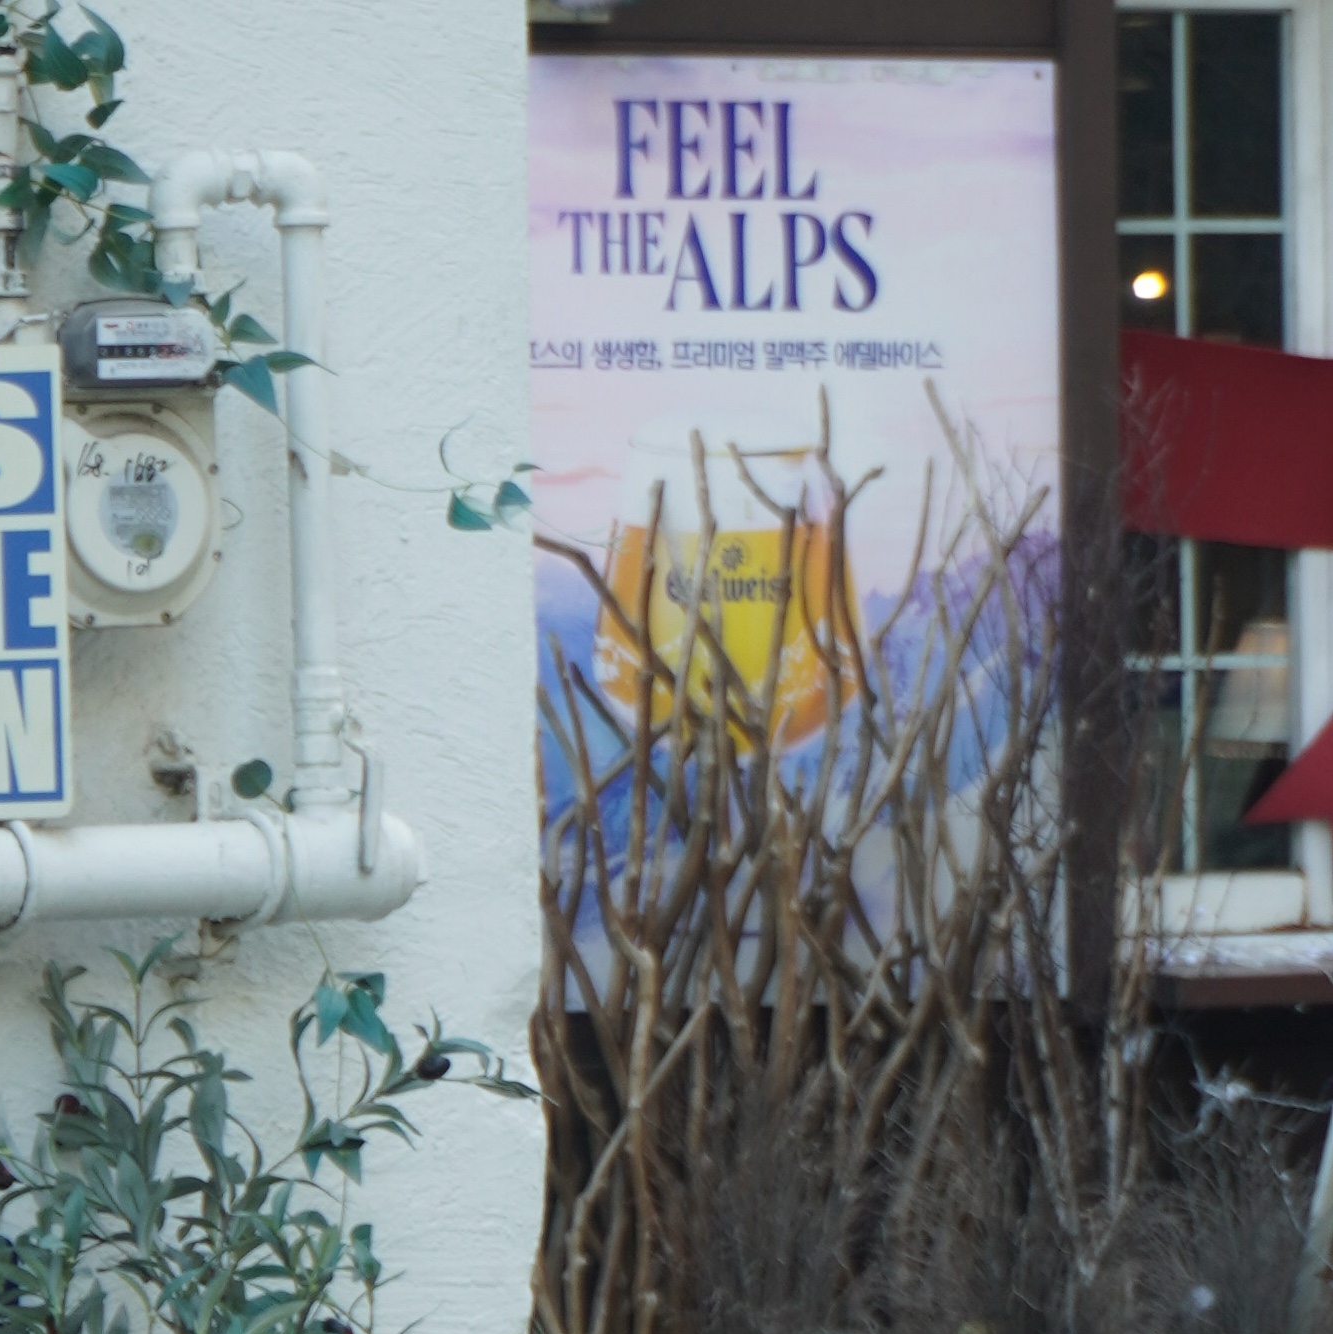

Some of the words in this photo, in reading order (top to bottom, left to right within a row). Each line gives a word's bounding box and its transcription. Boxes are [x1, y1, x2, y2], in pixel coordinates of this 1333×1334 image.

[613, 99, 818, 200] FEEL
[557, 210, 666, 275] THE
[663, 210, 879, 312] ALPS
[670, 340, 755, 370] 프리미엄
[763, 340, 828, 370] 밀맥주
[836, 340, 944, 371] 에델바이스
